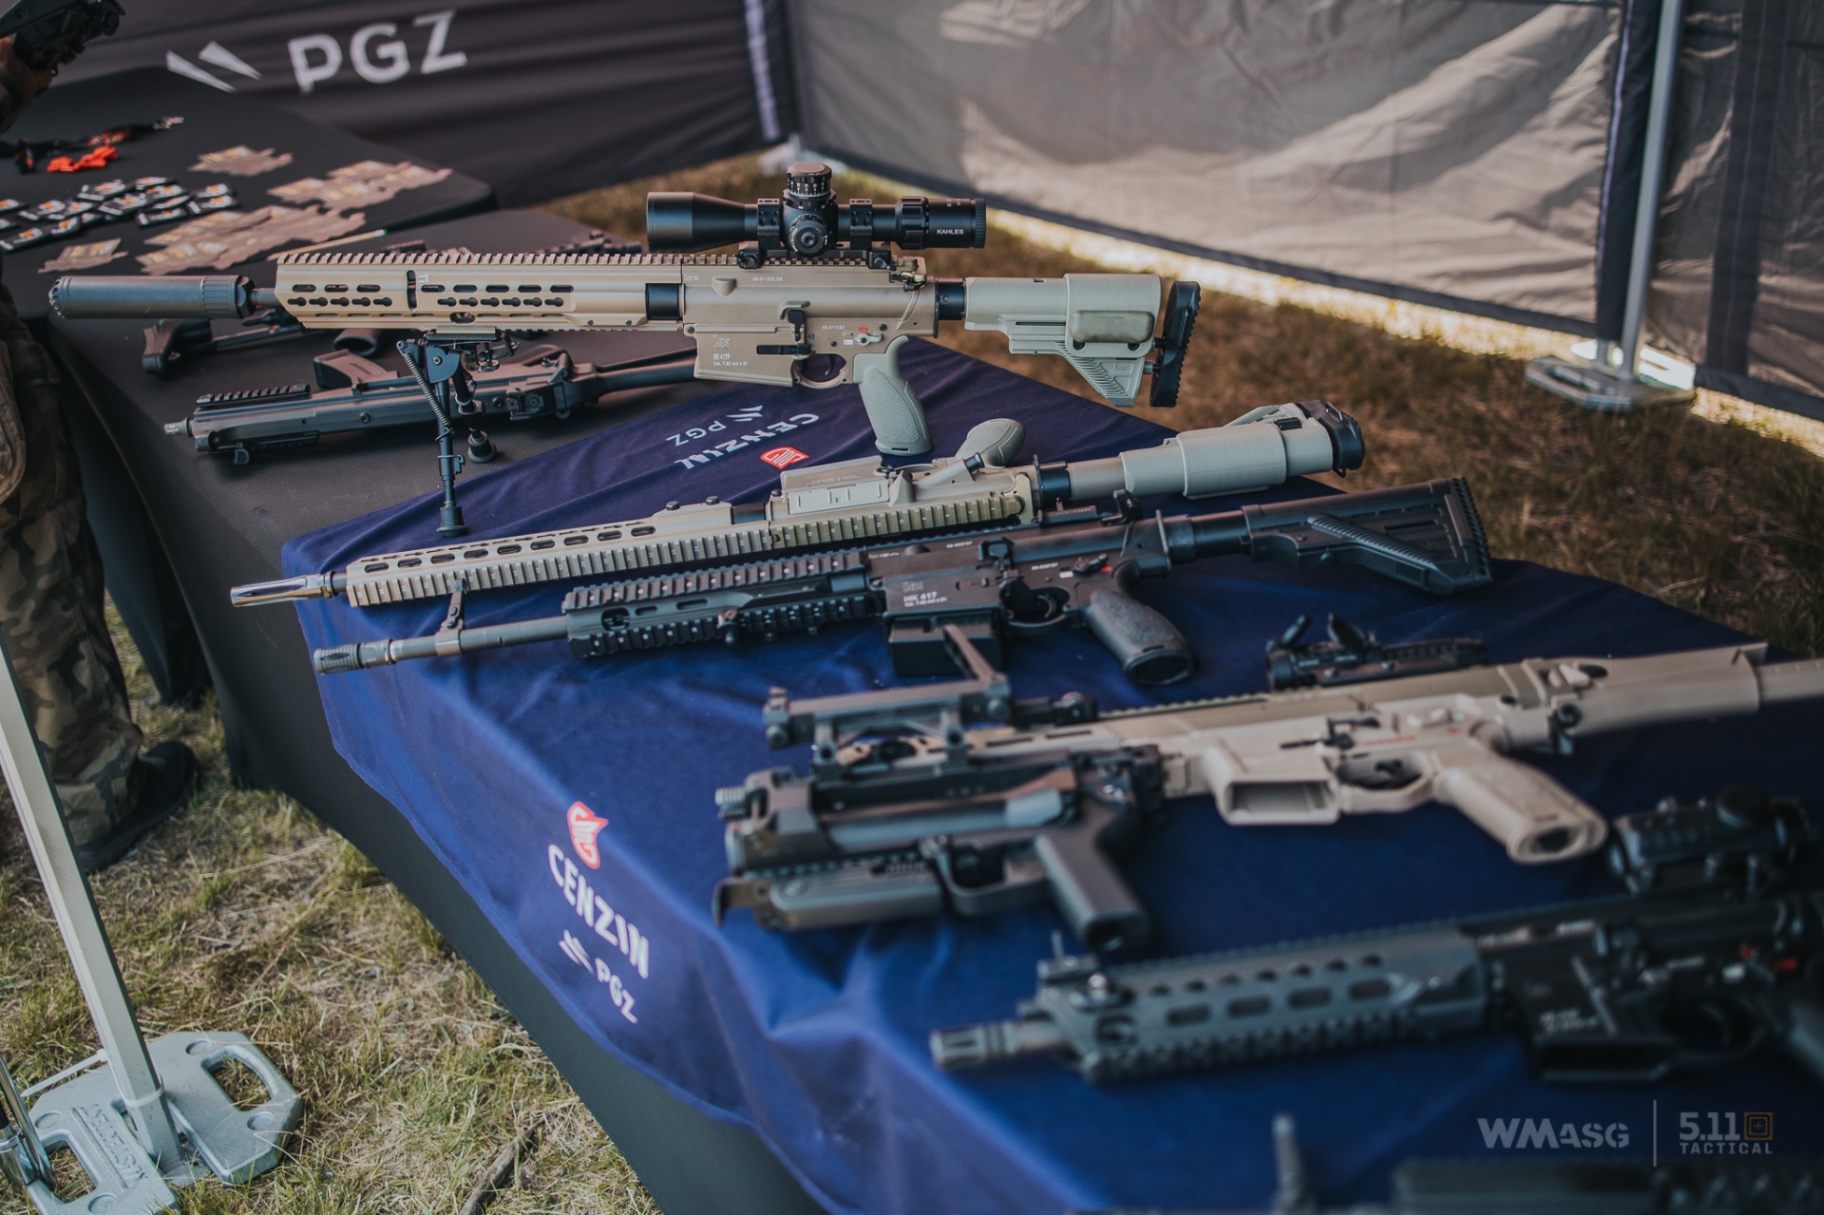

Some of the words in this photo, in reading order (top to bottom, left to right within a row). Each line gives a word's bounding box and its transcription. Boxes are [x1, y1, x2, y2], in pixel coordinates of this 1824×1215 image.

[287, 9, 468, 94] PGZ
[666, 420, 727, 446] PGZ
[674, 413, 820, 470] CENZIN
[548, 844, 649, 980] CENZIN
[594, 957, 638, 1024] PGZ
